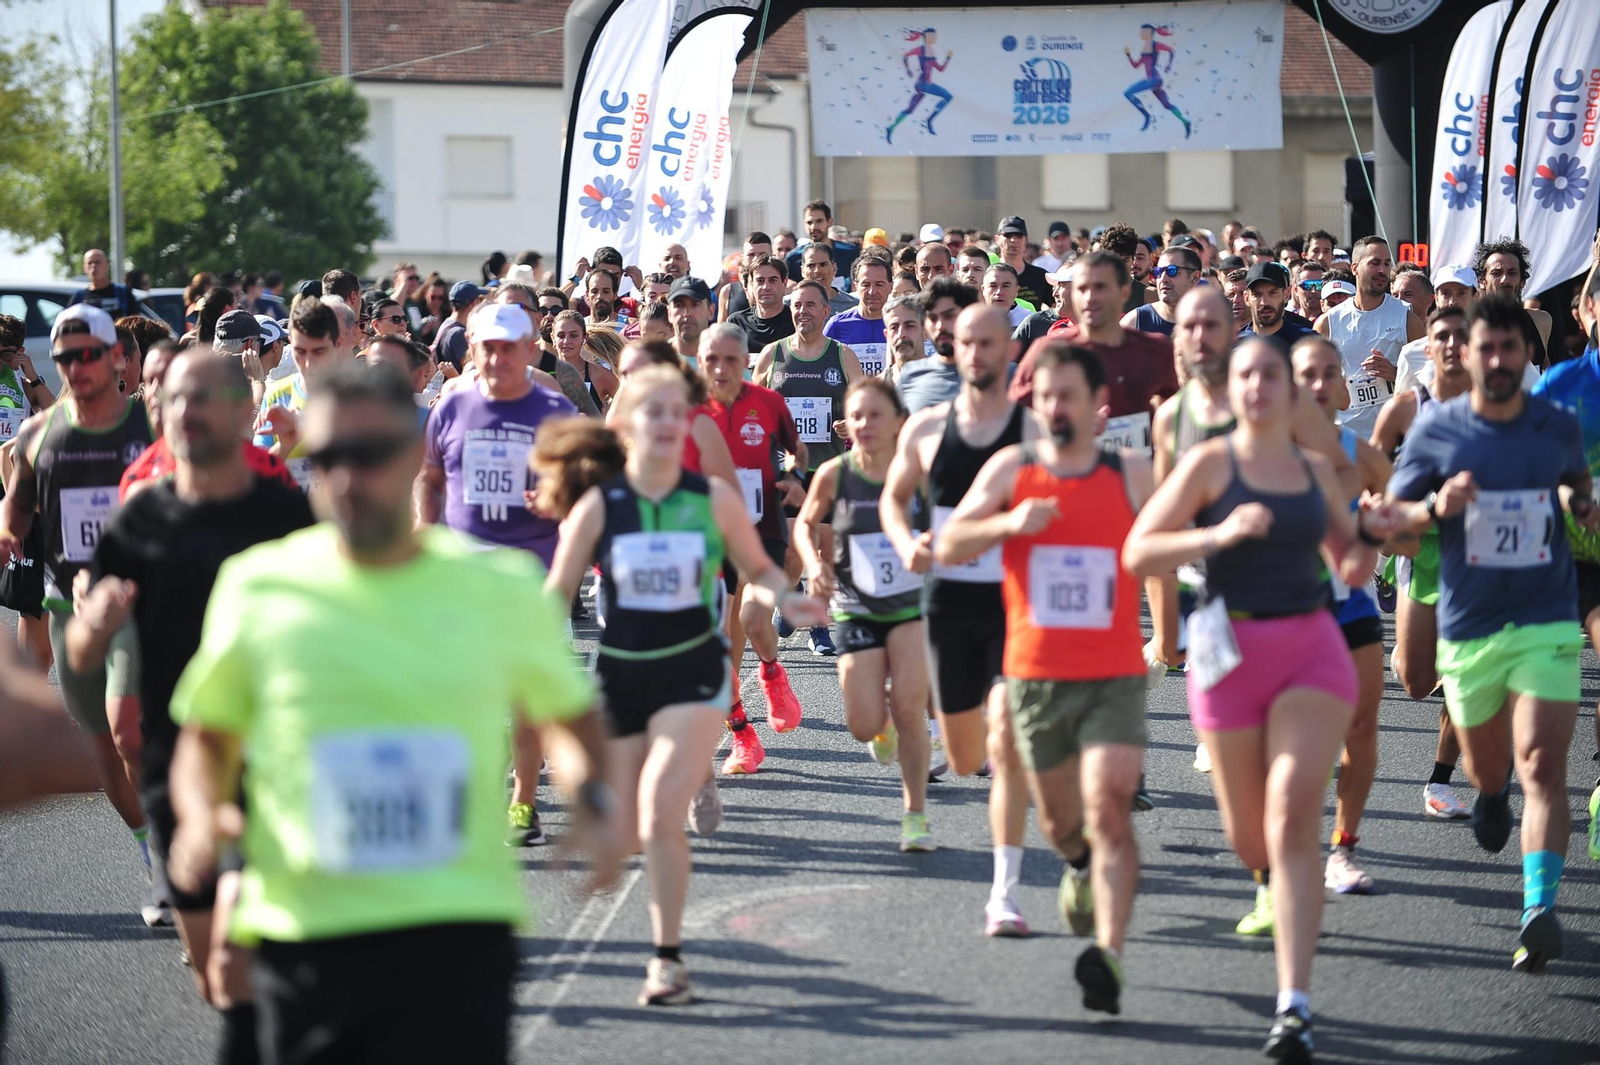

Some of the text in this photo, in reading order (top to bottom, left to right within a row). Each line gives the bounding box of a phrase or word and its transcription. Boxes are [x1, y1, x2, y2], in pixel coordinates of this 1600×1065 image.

[1357, 8, 1413, 26] OURENSE
[1041, 42, 1084, 50] OURENSE
[1013, 105, 1070, 125] 2026
[1536, 67, 1584, 146] chc
[583, 89, 629, 166] chc
[1444, 92, 1474, 156] chc
[652, 107, 690, 177] chc
[1399, 243, 1428, 267] 00
[1357, 385, 1378, 402] 910
[795, 418, 817, 434] 618
[475, 469, 512, 493] 305
[1496, 525, 1518, 554] 21
